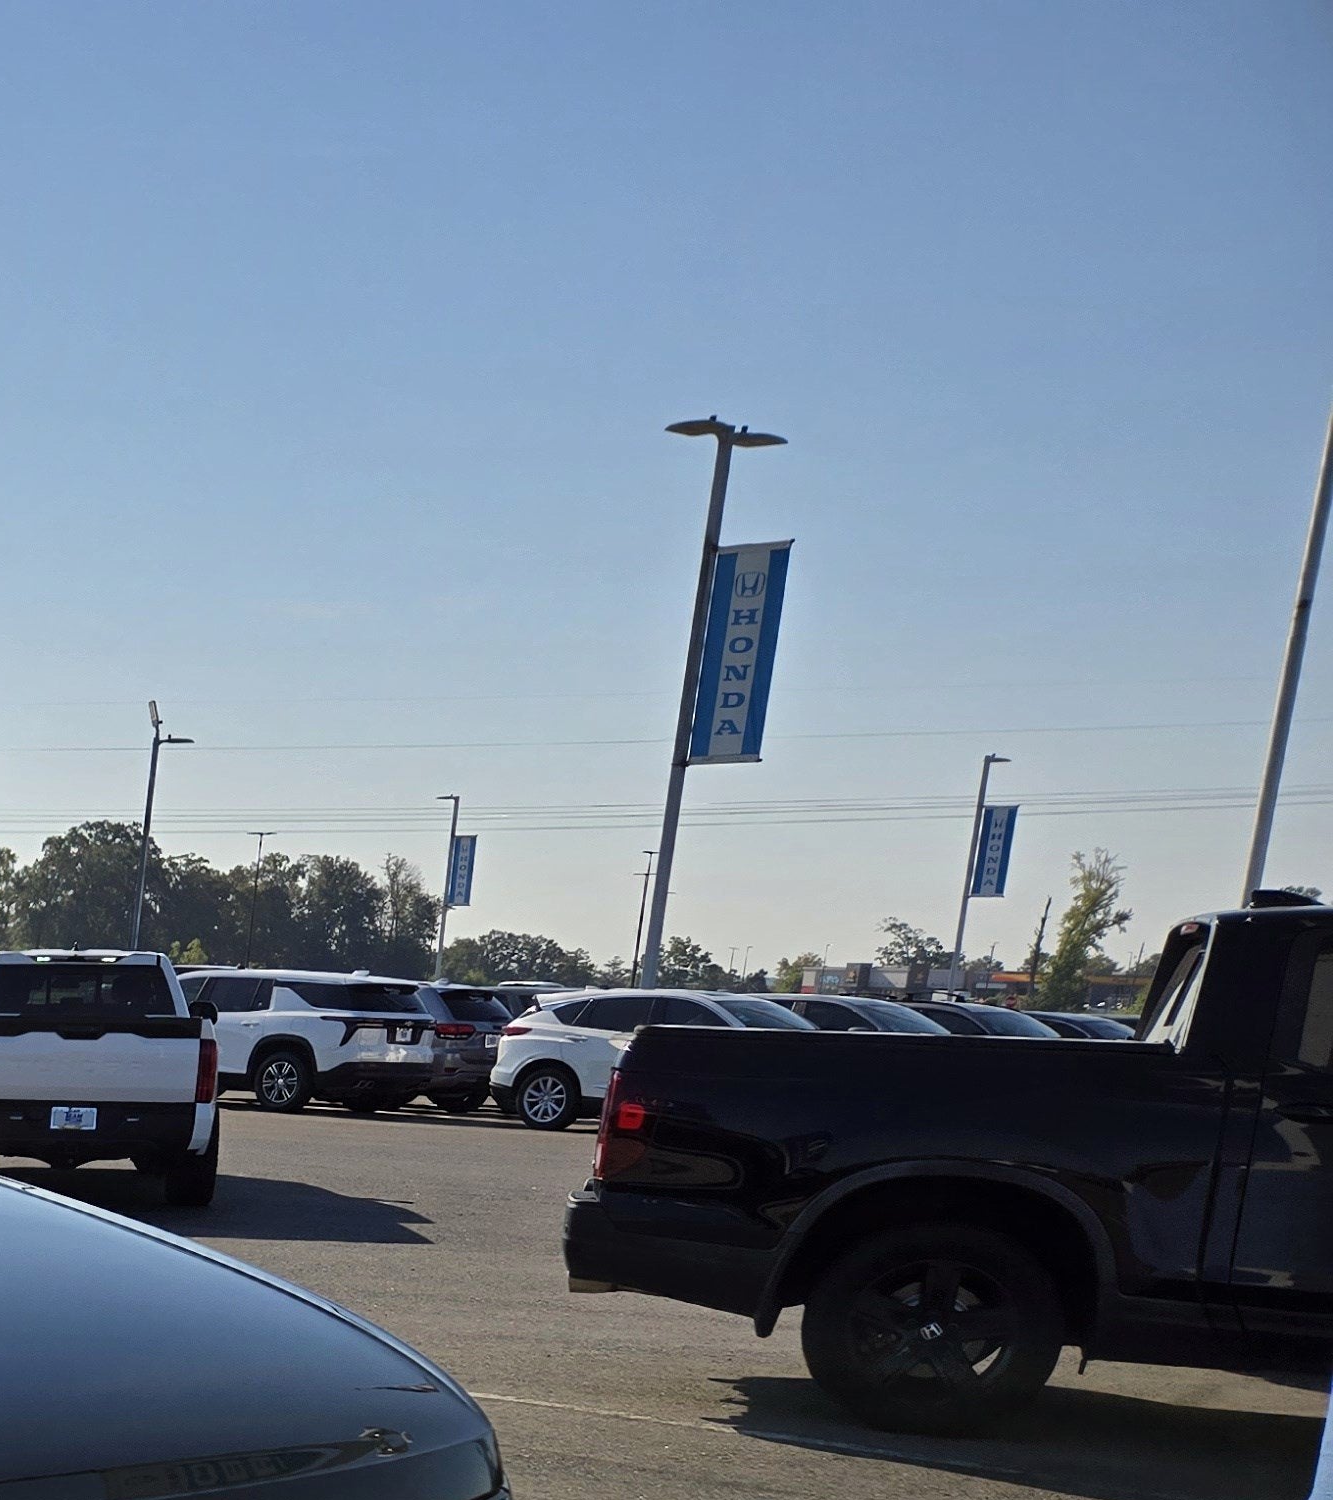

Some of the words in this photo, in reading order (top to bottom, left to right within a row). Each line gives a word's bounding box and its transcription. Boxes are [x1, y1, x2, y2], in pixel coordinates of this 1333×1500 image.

[714, 608, 760, 735] HONDA
[456, 855, 468, 897] HONDA
[984, 832, 1003, 886] HONDA
